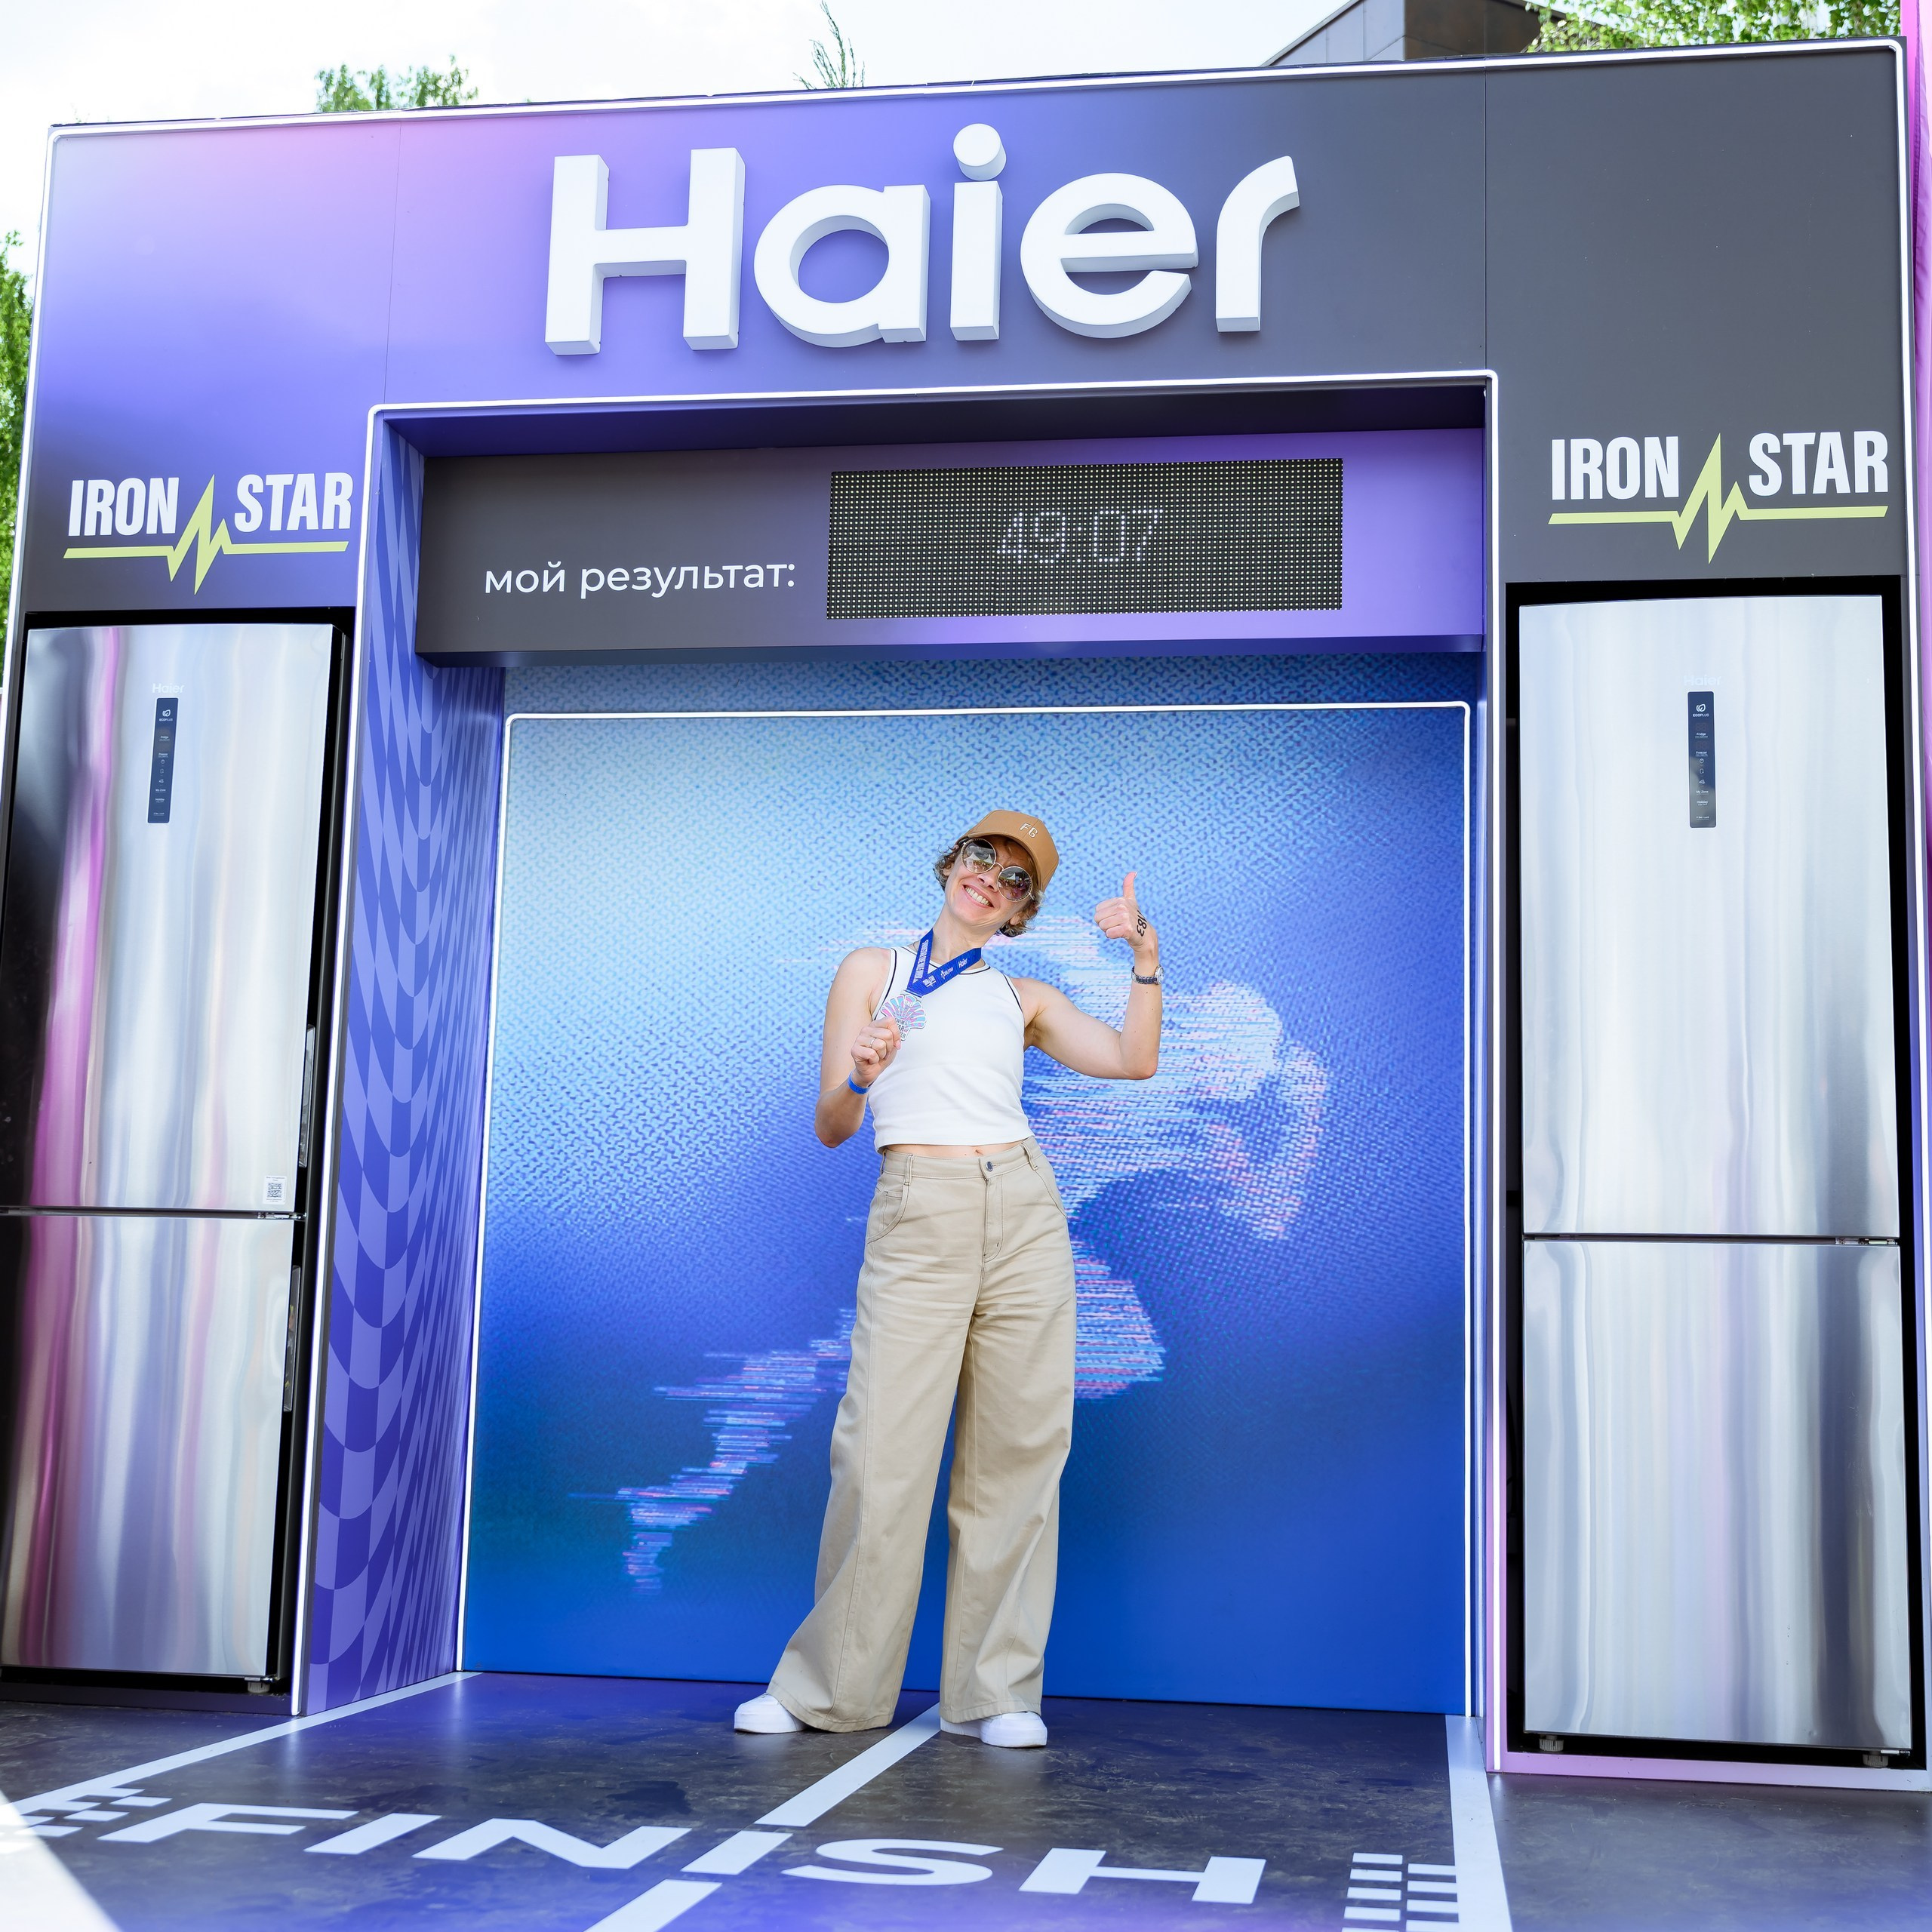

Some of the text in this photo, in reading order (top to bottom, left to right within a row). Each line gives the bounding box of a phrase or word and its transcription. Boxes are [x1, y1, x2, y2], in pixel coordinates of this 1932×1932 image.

[545, 123, 1300, 355] Haier
[1552, 430, 1889, 500] IRON STAR
[68, 472, 353, 537] IRON STAR
[996, 509, 1164, 565] 49:07
[485, 561, 796, 599] мой результат:
[152, 683, 185, 694] Haier
[1684, 673, 1721, 686] Haier
[1020, 823, 1038, 838] FG
[98, 1802, 1266, 1904] FINISH
